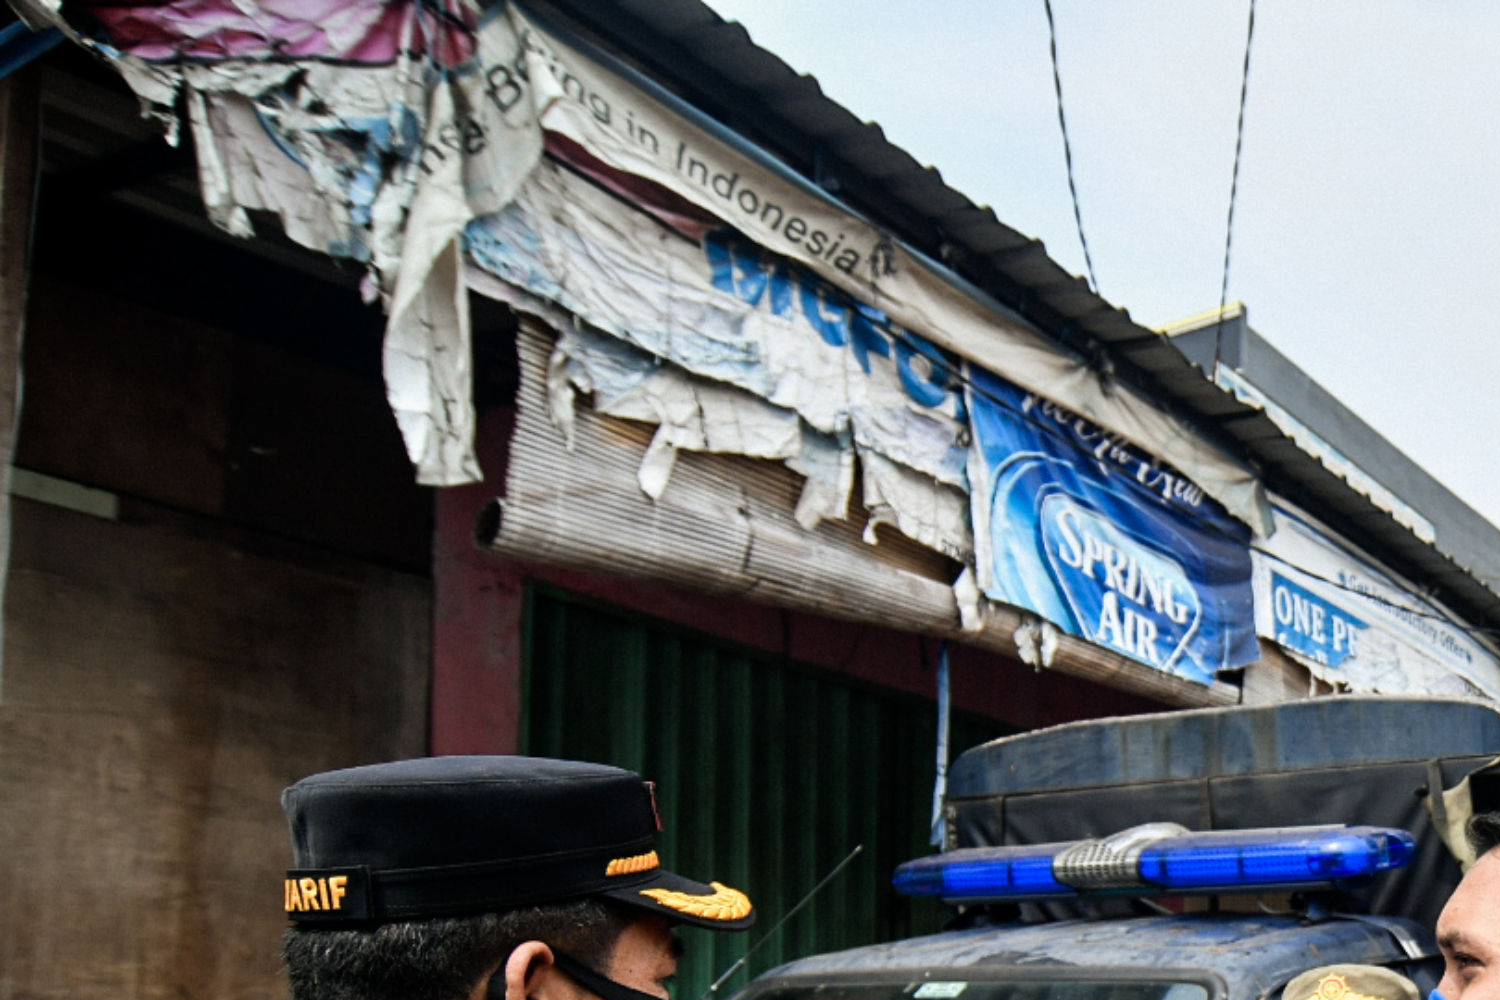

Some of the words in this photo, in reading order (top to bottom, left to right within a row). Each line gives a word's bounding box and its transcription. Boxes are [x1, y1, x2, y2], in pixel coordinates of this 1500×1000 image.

[624, 111, 661, 154] in
[675, 141, 862, 277] Indonesia
[1055, 508, 1188, 625] SPRING
[1096, 590, 1160, 664] AIR
[1275, 585, 1327, 645] ONE
